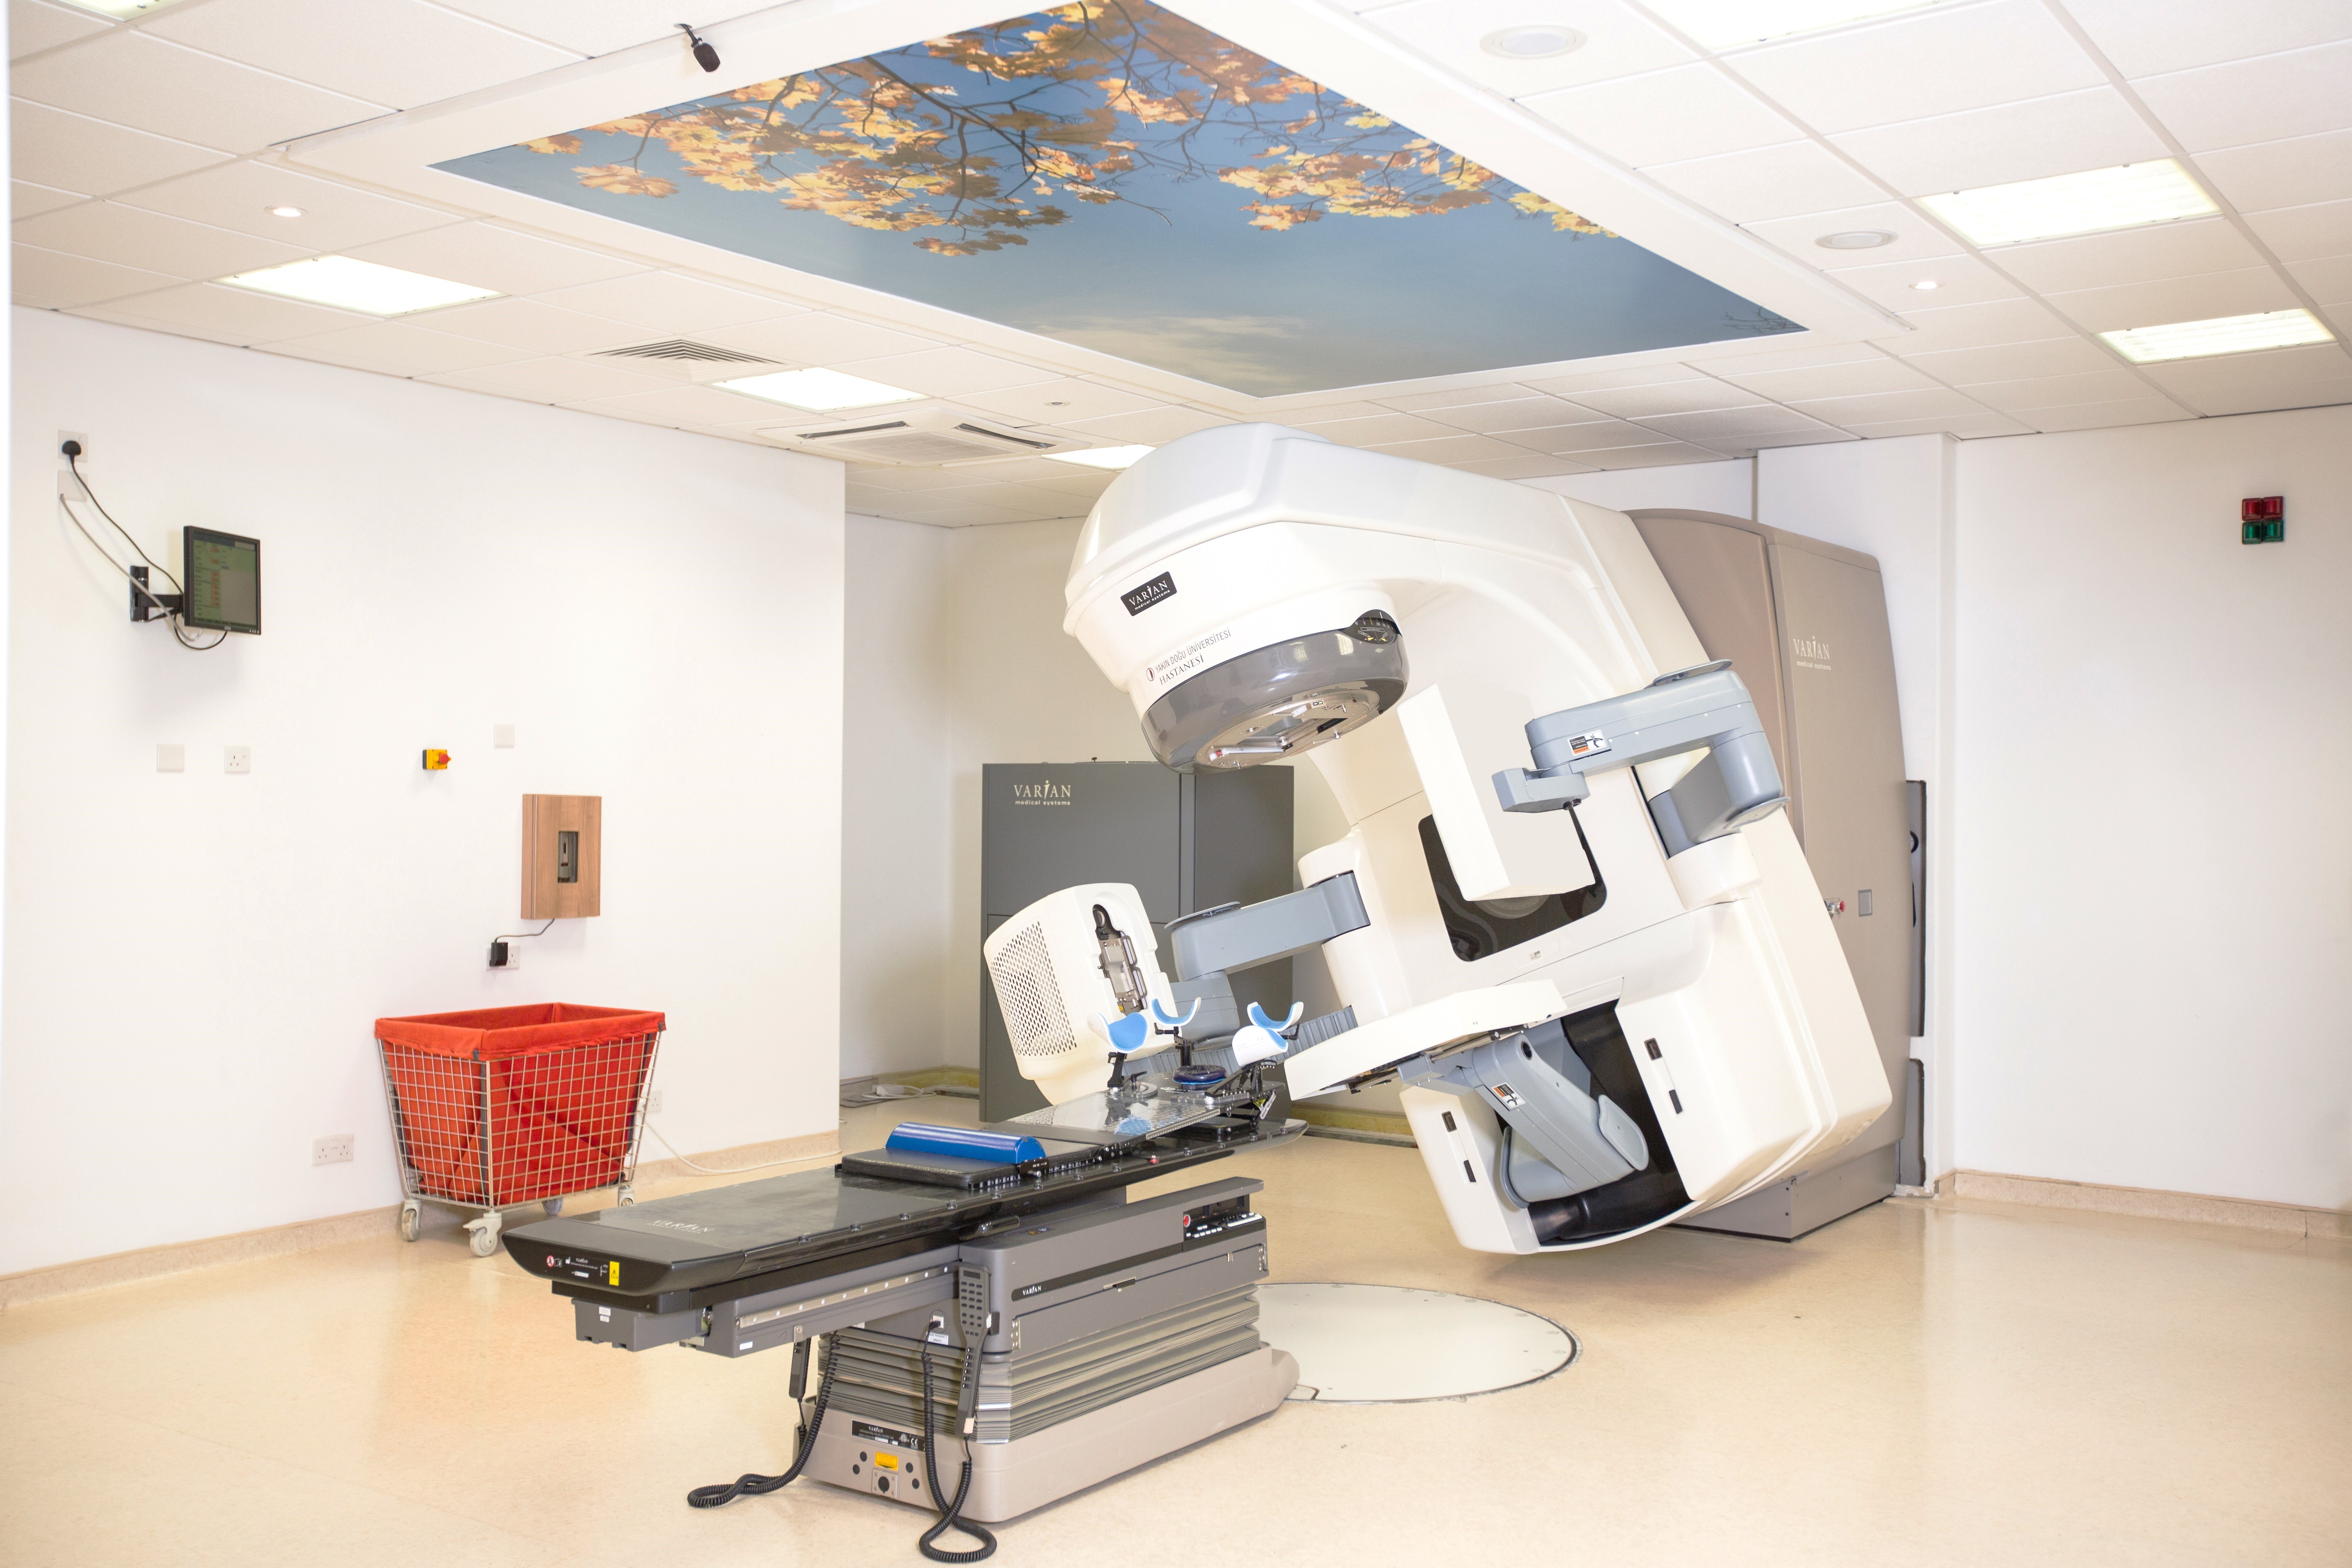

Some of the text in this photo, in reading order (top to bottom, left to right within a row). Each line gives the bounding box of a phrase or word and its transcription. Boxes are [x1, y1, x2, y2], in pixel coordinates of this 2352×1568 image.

[1134, 590, 1170, 610] medical systems
[1155, 627, 1231, 673] YAKIN DOĞU ÜNİVERSİTESİ
[1159, 653, 1204, 685] HASTANESİ
